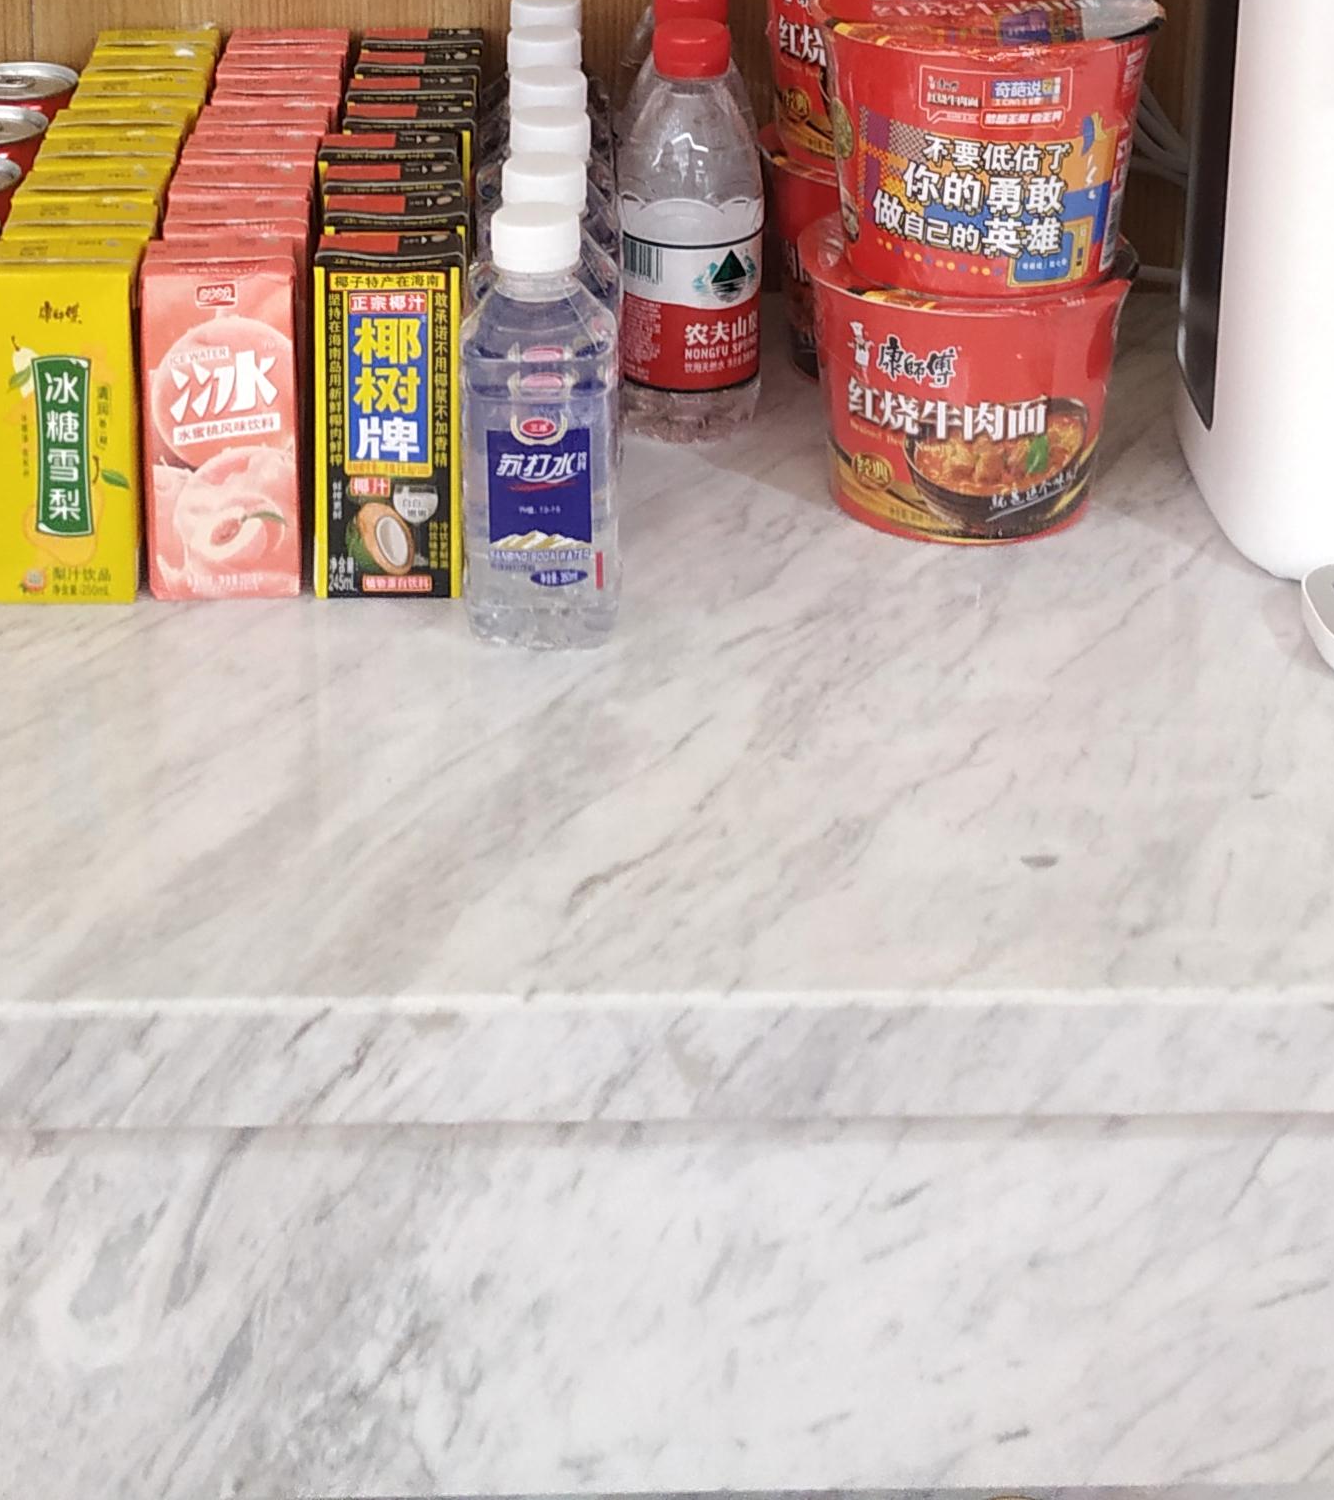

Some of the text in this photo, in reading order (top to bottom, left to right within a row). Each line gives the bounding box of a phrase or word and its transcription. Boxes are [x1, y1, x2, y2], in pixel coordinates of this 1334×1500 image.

[924, 135, 1069, 172] 不要低估了
[903, 161, 1065, 214] 你的勇敢
[873, 189, 1061, 255] 做自己的英雄
[334, 274, 440, 289] 椰子特产在海南
[351, 294, 425, 312] 正宗椰汁
[685, 344, 728, 360] NONGFU
[353, 317, 422, 461] 椰树牌
[847, 377, 1047, 441] 红烧牛肉面
[45, 372, 82, 521] 冰糖雪梨
[177, 417, 275, 442] 水蜜桃风味饮料
[496, 452, 577, 484] 苏打水
[353, 477, 389, 496] 椰汁
